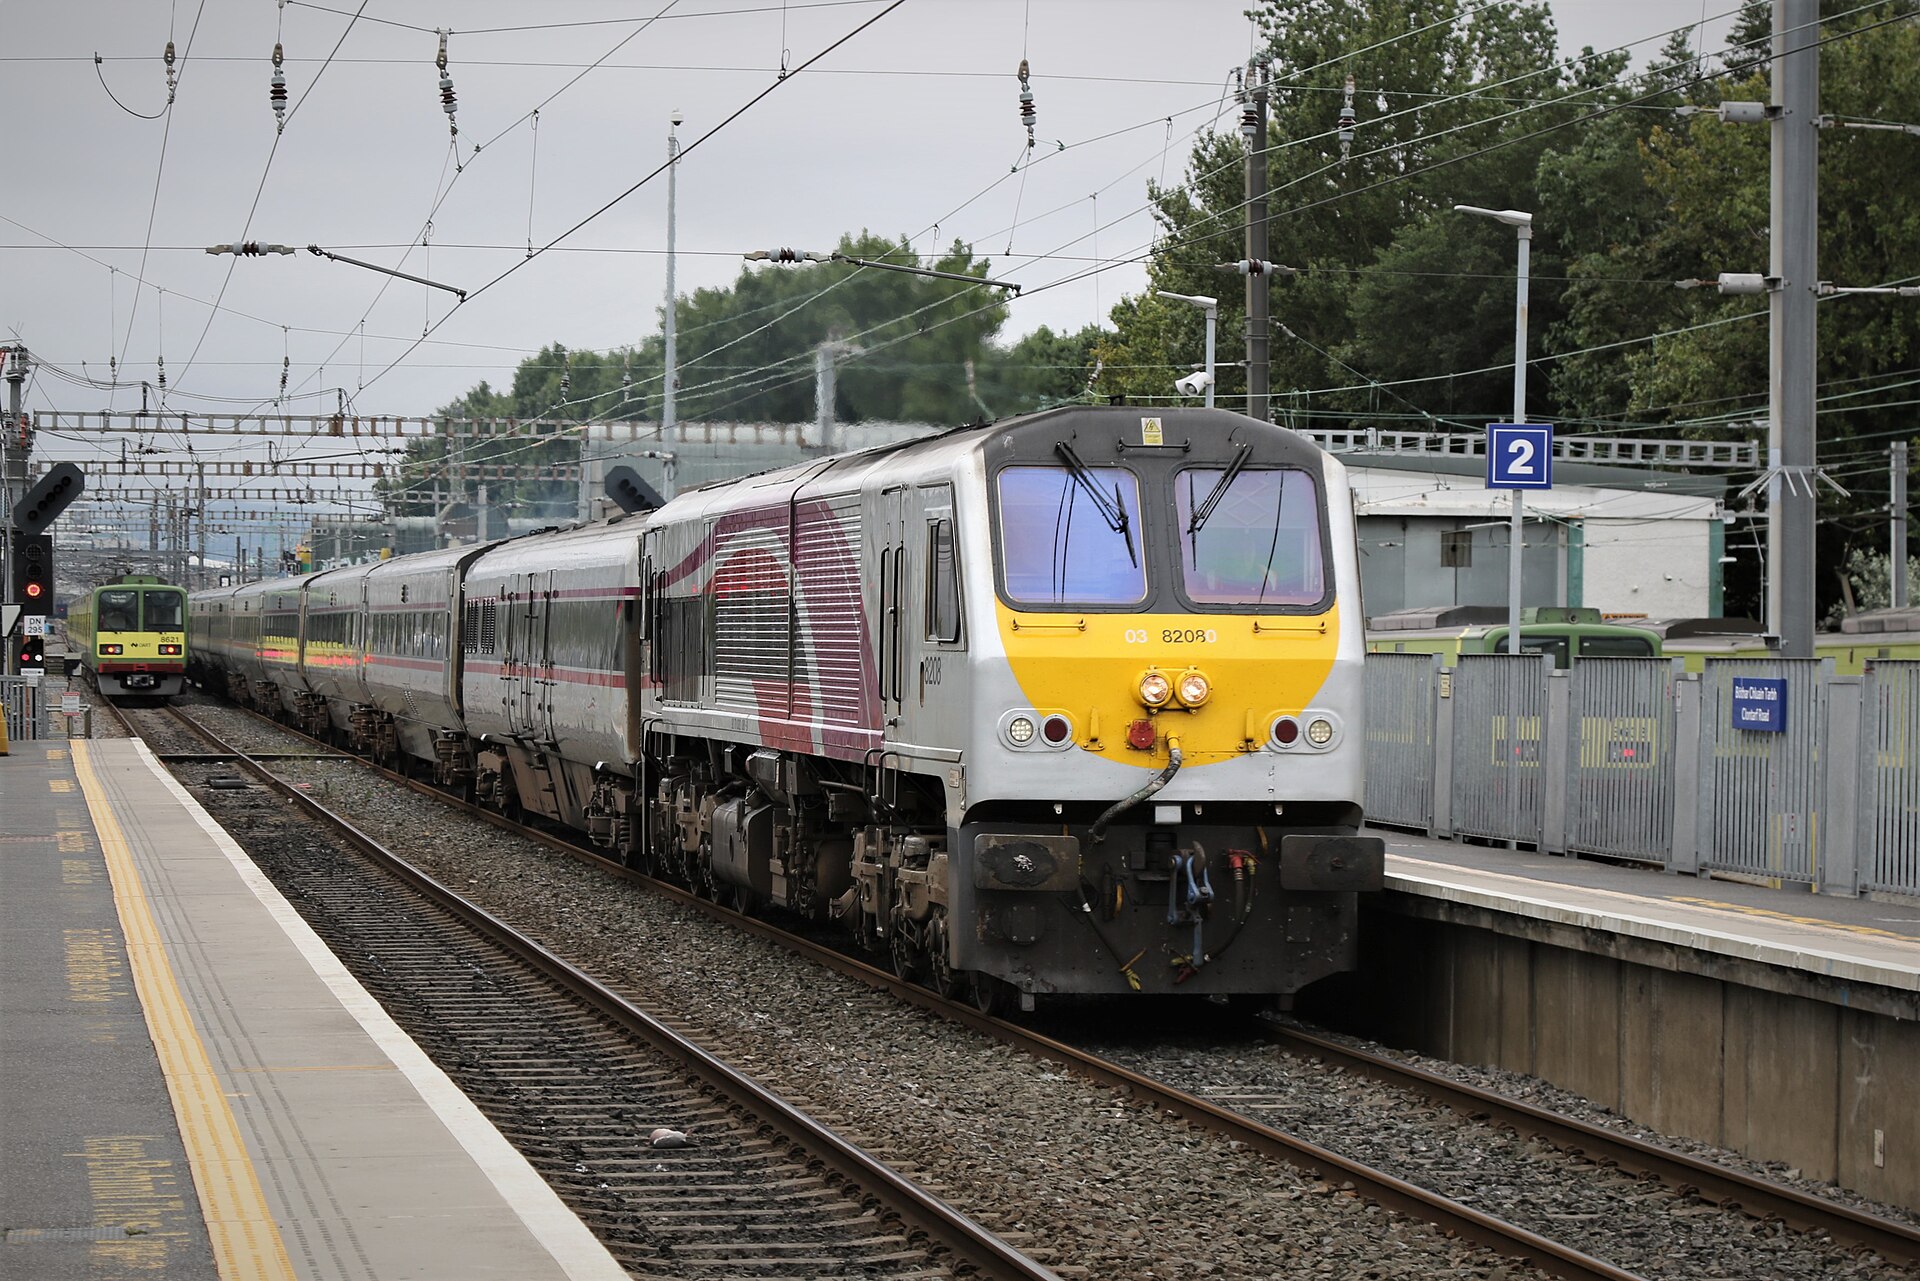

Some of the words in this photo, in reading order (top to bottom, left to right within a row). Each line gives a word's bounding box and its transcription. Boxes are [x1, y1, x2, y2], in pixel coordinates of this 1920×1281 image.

[1507, 438, 1534, 474] 2
[28, 626, 43, 634] 295
[1125, 629, 1149, 643] 03
[925, 656, 941, 685] 8208
